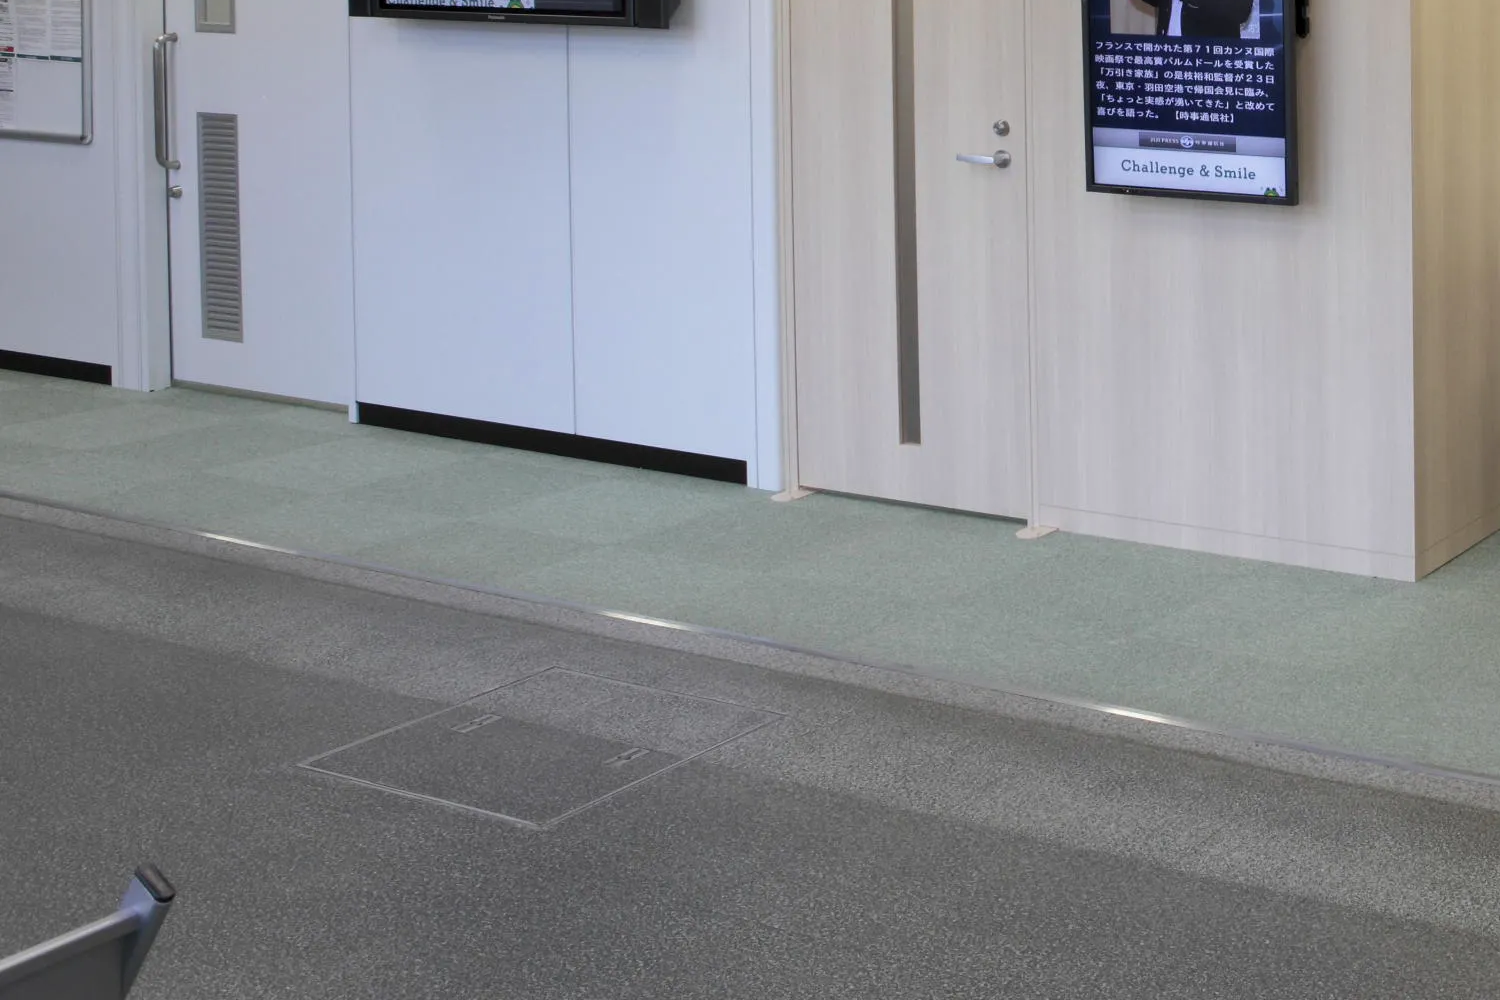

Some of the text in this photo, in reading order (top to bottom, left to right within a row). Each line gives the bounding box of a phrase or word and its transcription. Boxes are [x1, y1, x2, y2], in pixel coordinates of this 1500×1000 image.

[1121, 159, 1256, 180] Challenge & Smile
